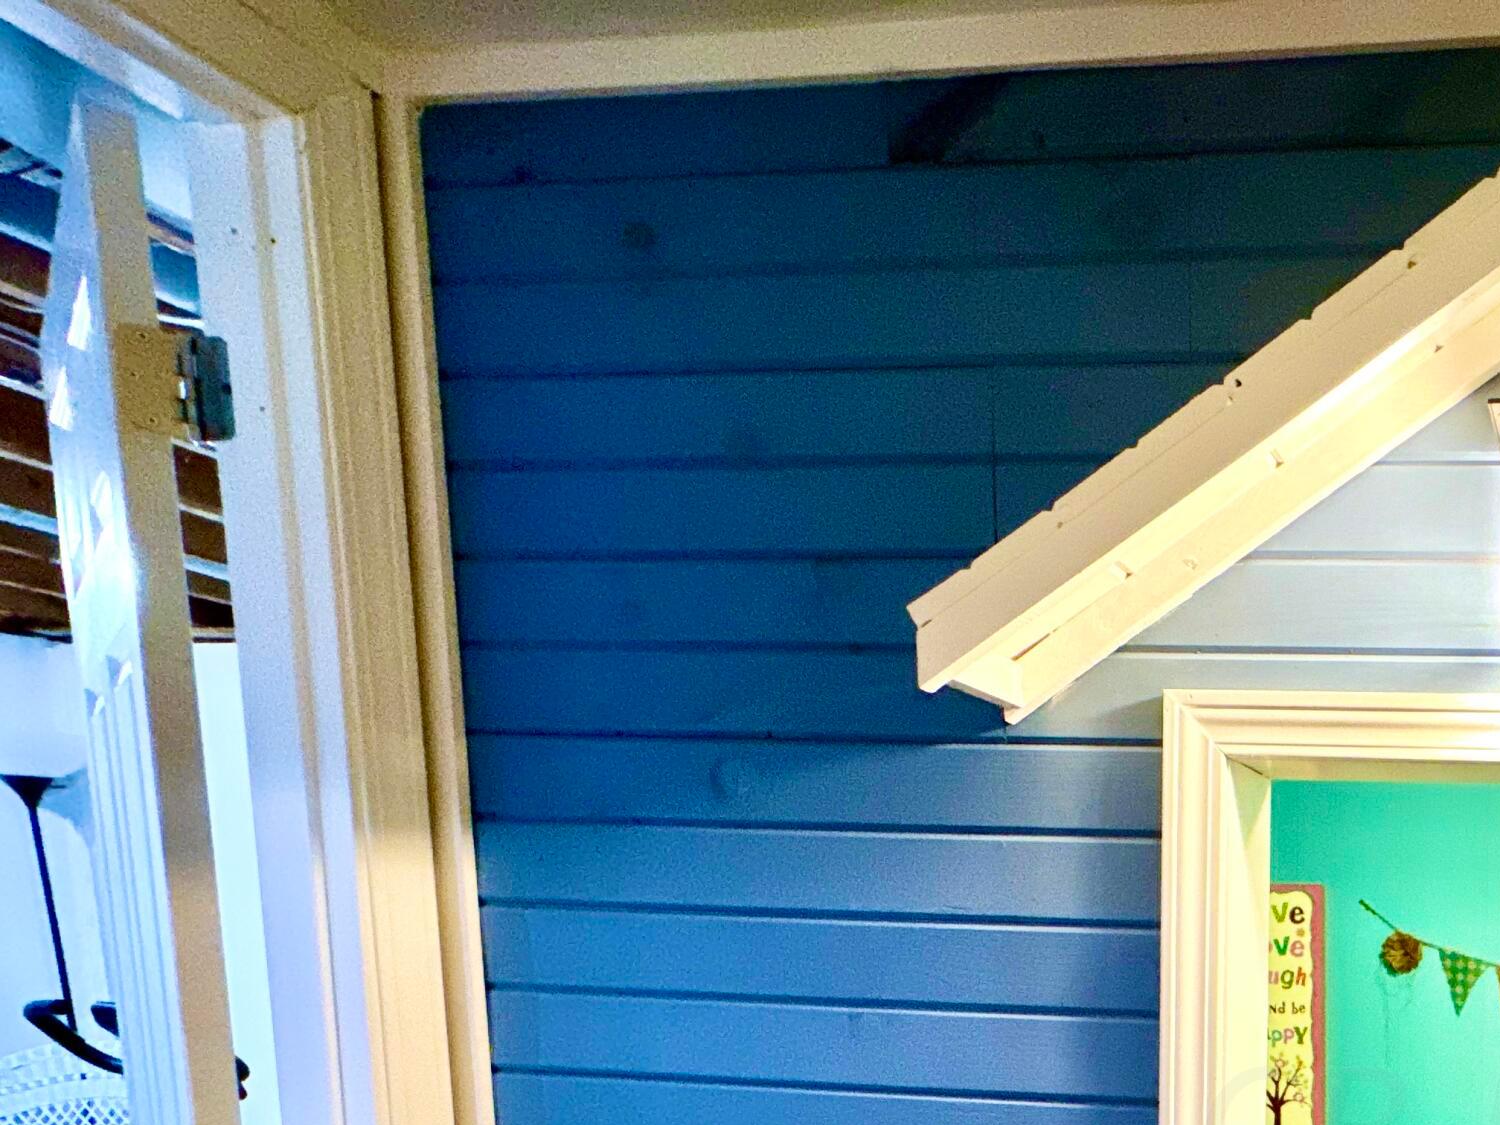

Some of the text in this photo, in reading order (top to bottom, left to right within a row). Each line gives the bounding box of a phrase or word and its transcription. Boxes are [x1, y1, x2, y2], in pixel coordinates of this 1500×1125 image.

[1271, 902, 1305, 924] ve
[1269, 936, 1304, 957] ve
[1268, 966, 1306, 989] ugh
[1292, 1001, 1306, 1014] be
